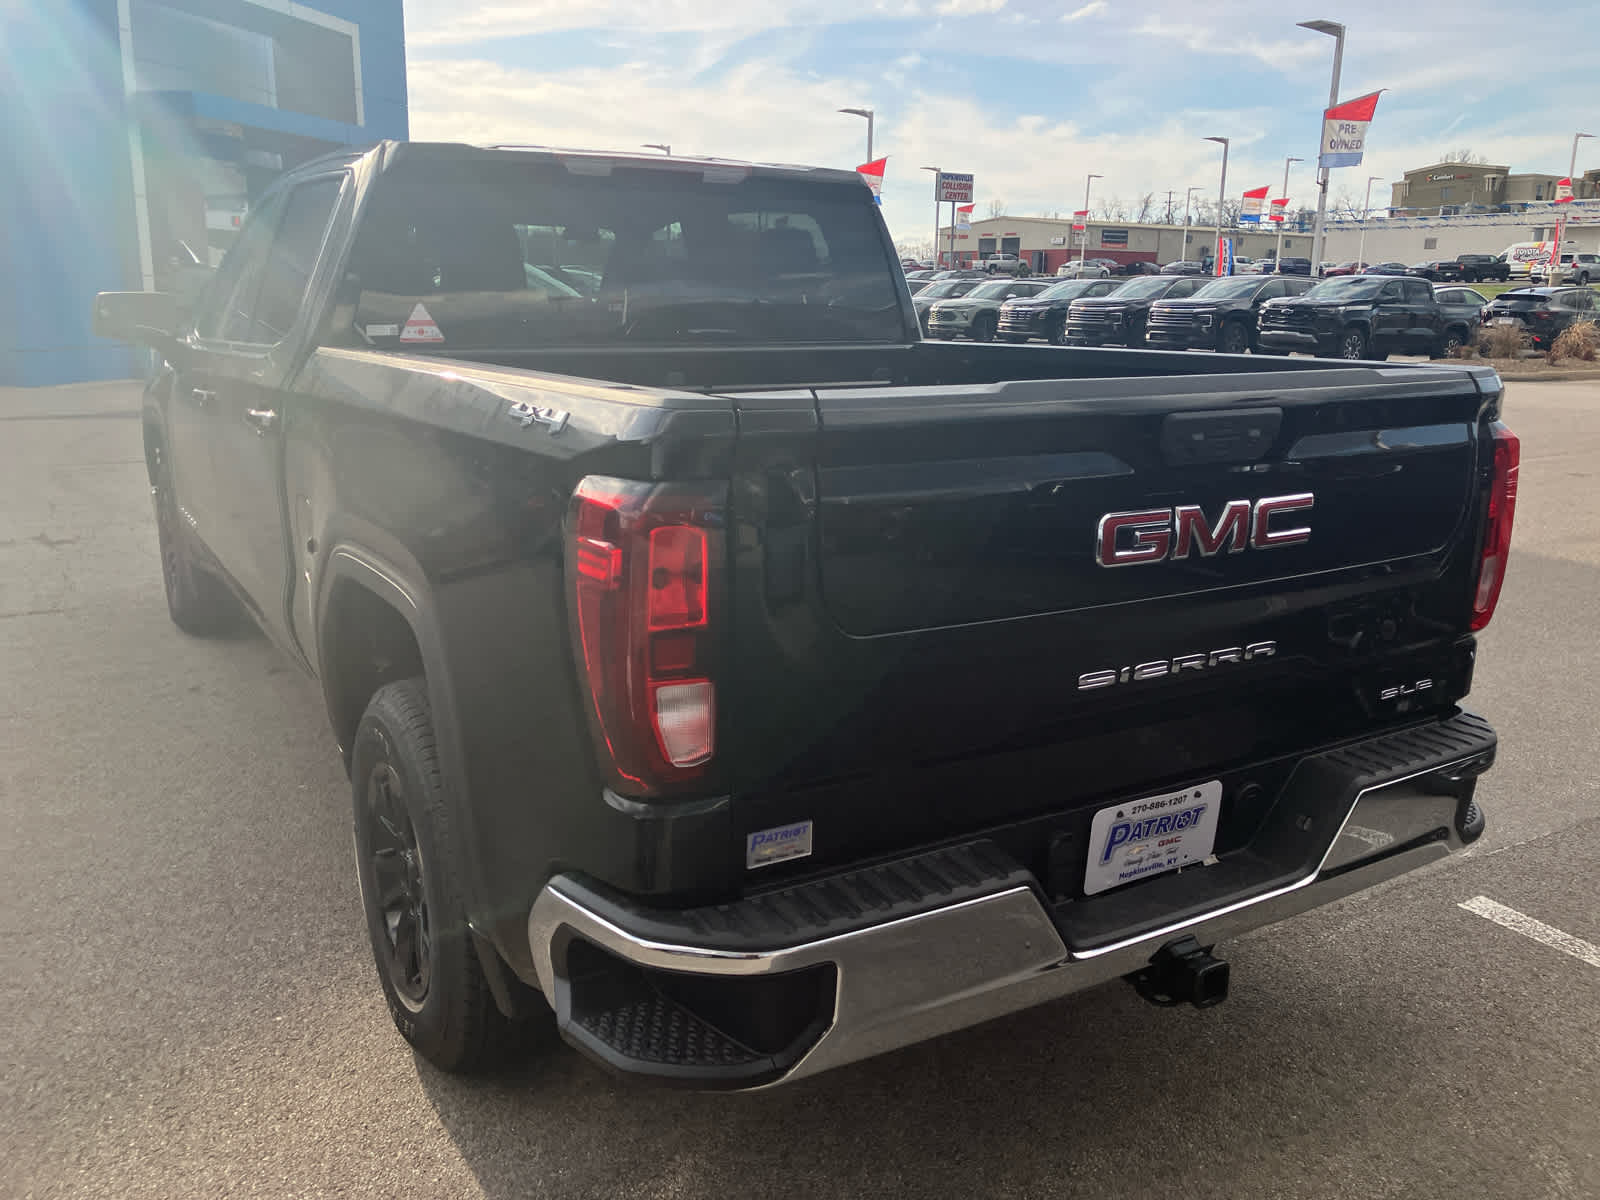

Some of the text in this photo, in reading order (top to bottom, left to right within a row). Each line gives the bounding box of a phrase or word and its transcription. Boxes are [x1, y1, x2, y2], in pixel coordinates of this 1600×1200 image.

[1329, 138, 1362, 151] OWNED
[941, 181, 973, 191] COLLISION
[944, 191, 969, 200] CENTER
[1096, 492, 1314, 568] GMC
[1078, 640, 1277, 690] SIERRA
[1380, 678, 1433, 701] SLE
[751, 824, 809, 852] PATRIOT
[1102, 805, 1207, 863] PATRIOT
[1157, 835, 1183, 848] GMC
[1167, 857, 1178, 866] KY
